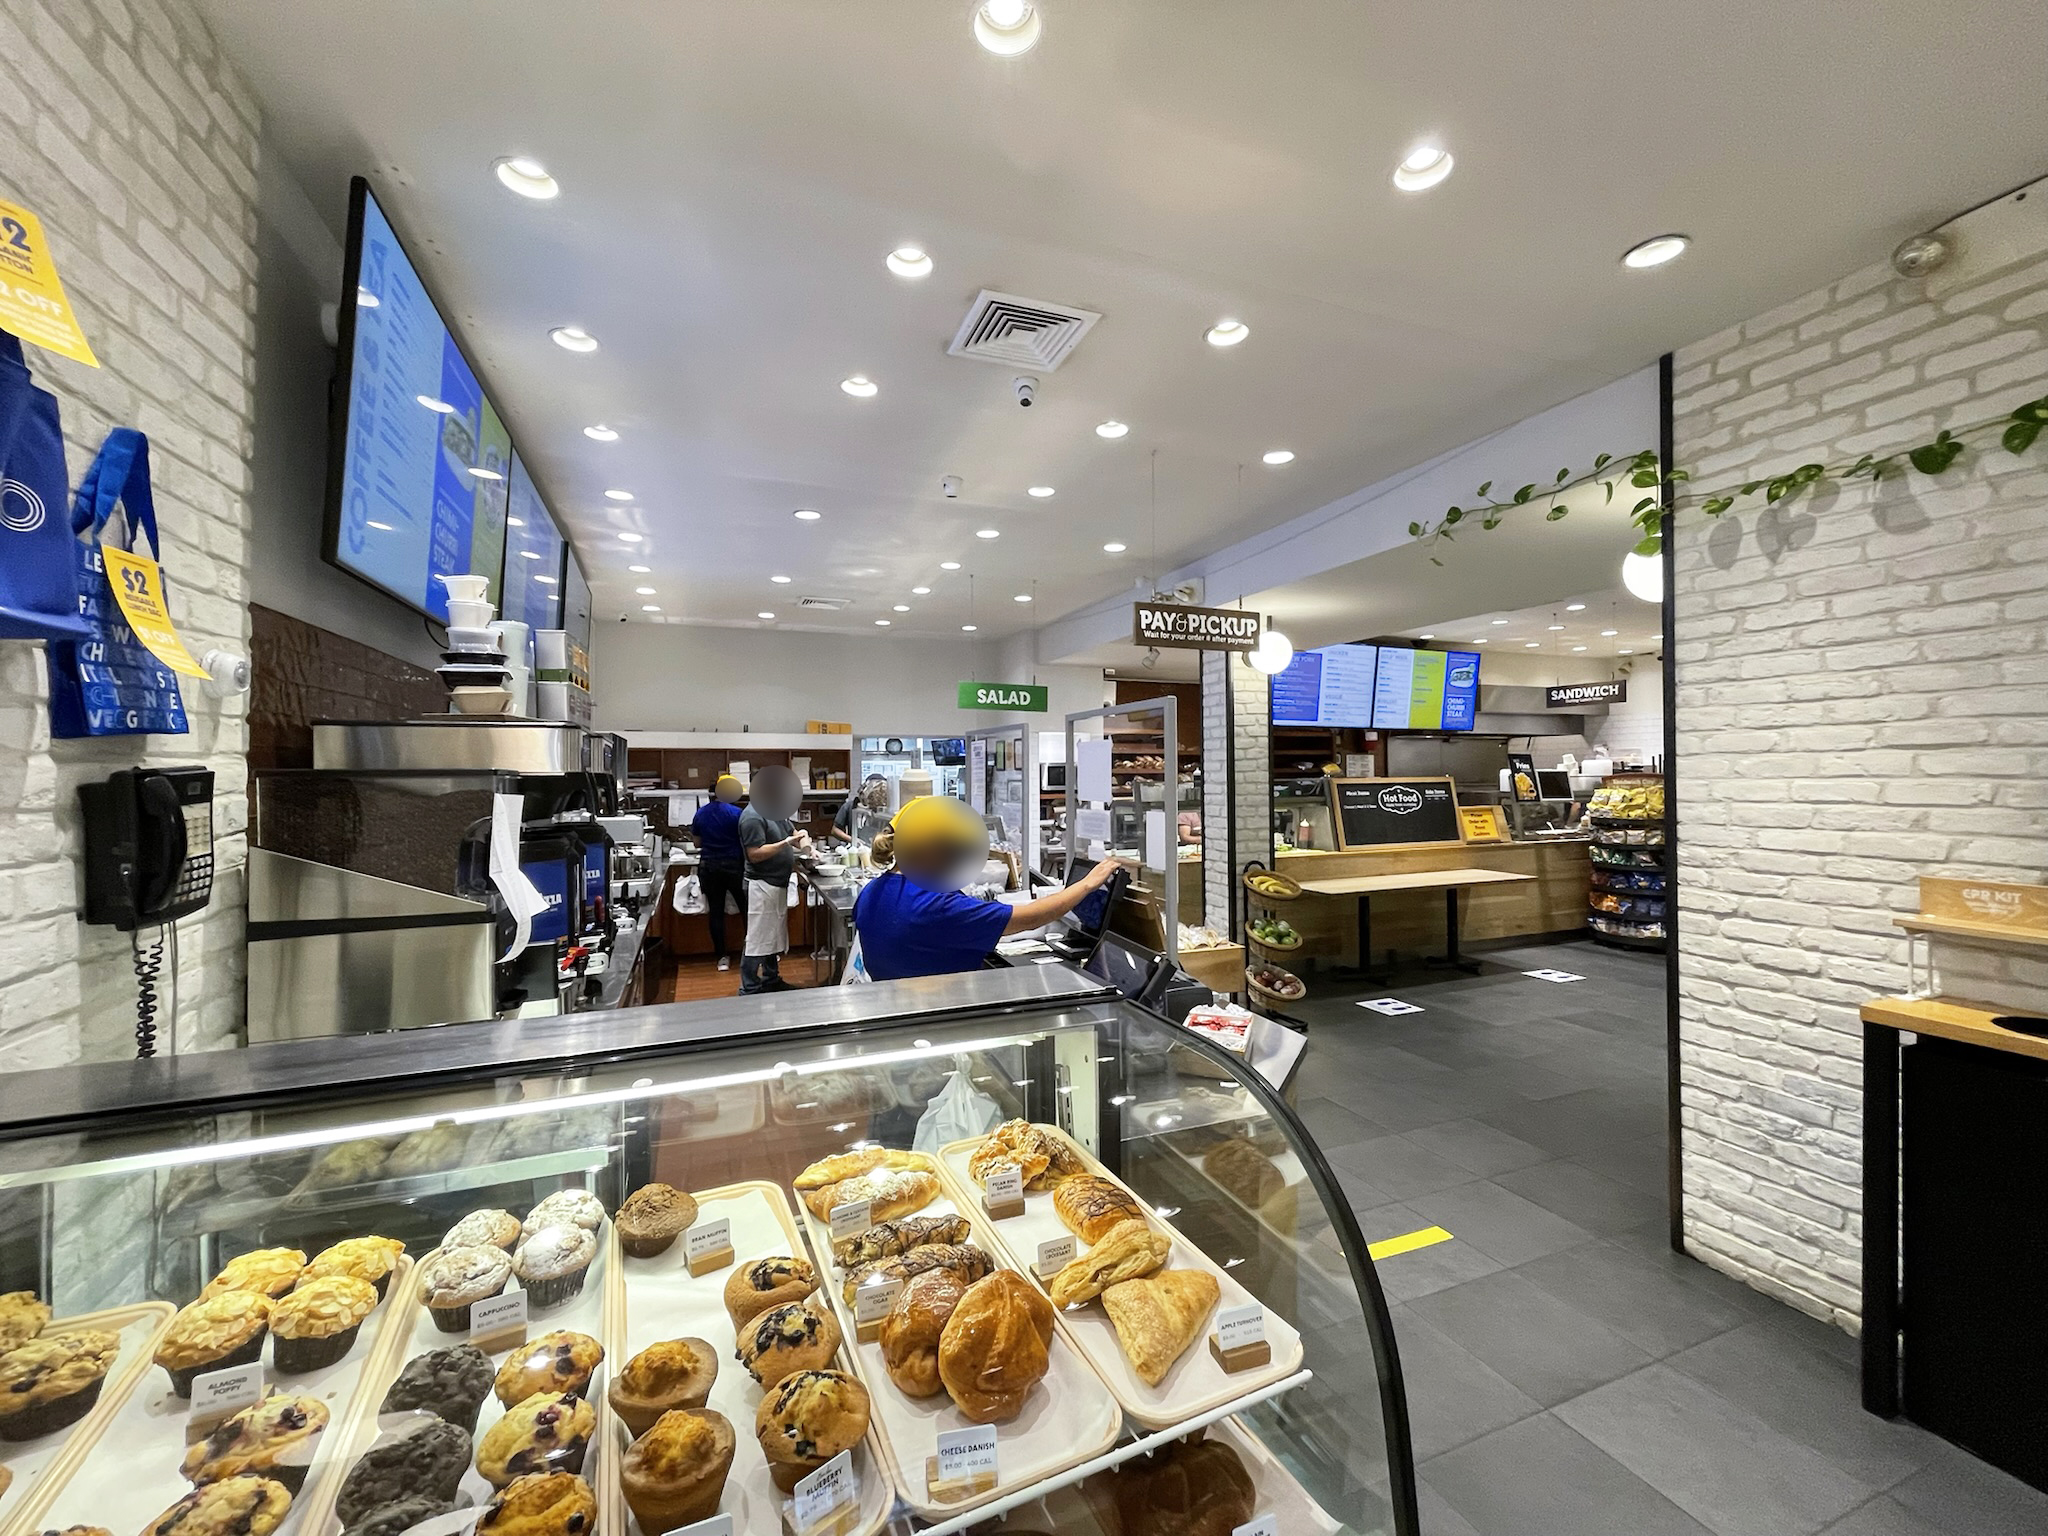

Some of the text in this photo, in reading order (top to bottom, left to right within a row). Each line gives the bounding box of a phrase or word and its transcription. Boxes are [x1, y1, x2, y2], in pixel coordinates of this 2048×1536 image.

[14, 287, 63, 317] OFF
[348, 370, 377, 555] COFFEE
[121, 566, 149, 596] $2
[1139, 609, 1258, 638] PAY & PICKUP
[152, 630, 176, 645] OFF
[1144, 630, 1160, 639] Wait
[1160, 630, 1171, 640] for
[1170, 633, 1187, 642] your
[1187, 634, 1205, 642] order
[1212, 634, 1227, 644] after
[1227, 636, 1255, 646] payment
[977, 689, 1031, 706] SALAD
[1551, 684, 1619, 701] SANDWICH
[1382, 794, 1398, 803] Hot
[1398, 793, 1418, 803] Food
[1994, 891, 2023, 904] KIT
[692, 1228, 727, 1243] BRAN MUFFIN
[1044, 1243, 1072, 1255] CHOCOLATE
[1046, 1249, 1072, 1261] CROISSANT
[865, 1290, 895, 1301] CHOCOLATE
[478, 1302, 521, 1318] CAPPUCCINO
[1221, 1316, 1263, 1331] APPLE TURNOVER
[208, 1376, 248, 1391] ALMOND
[213, 1384, 242, 1397] POPPY
[940, 1442, 995, 1457] CHEESE DANISH
[806, 1466, 843, 1497] BLUEBERRY
[812, 1478, 839, 1502] MUFFIN
